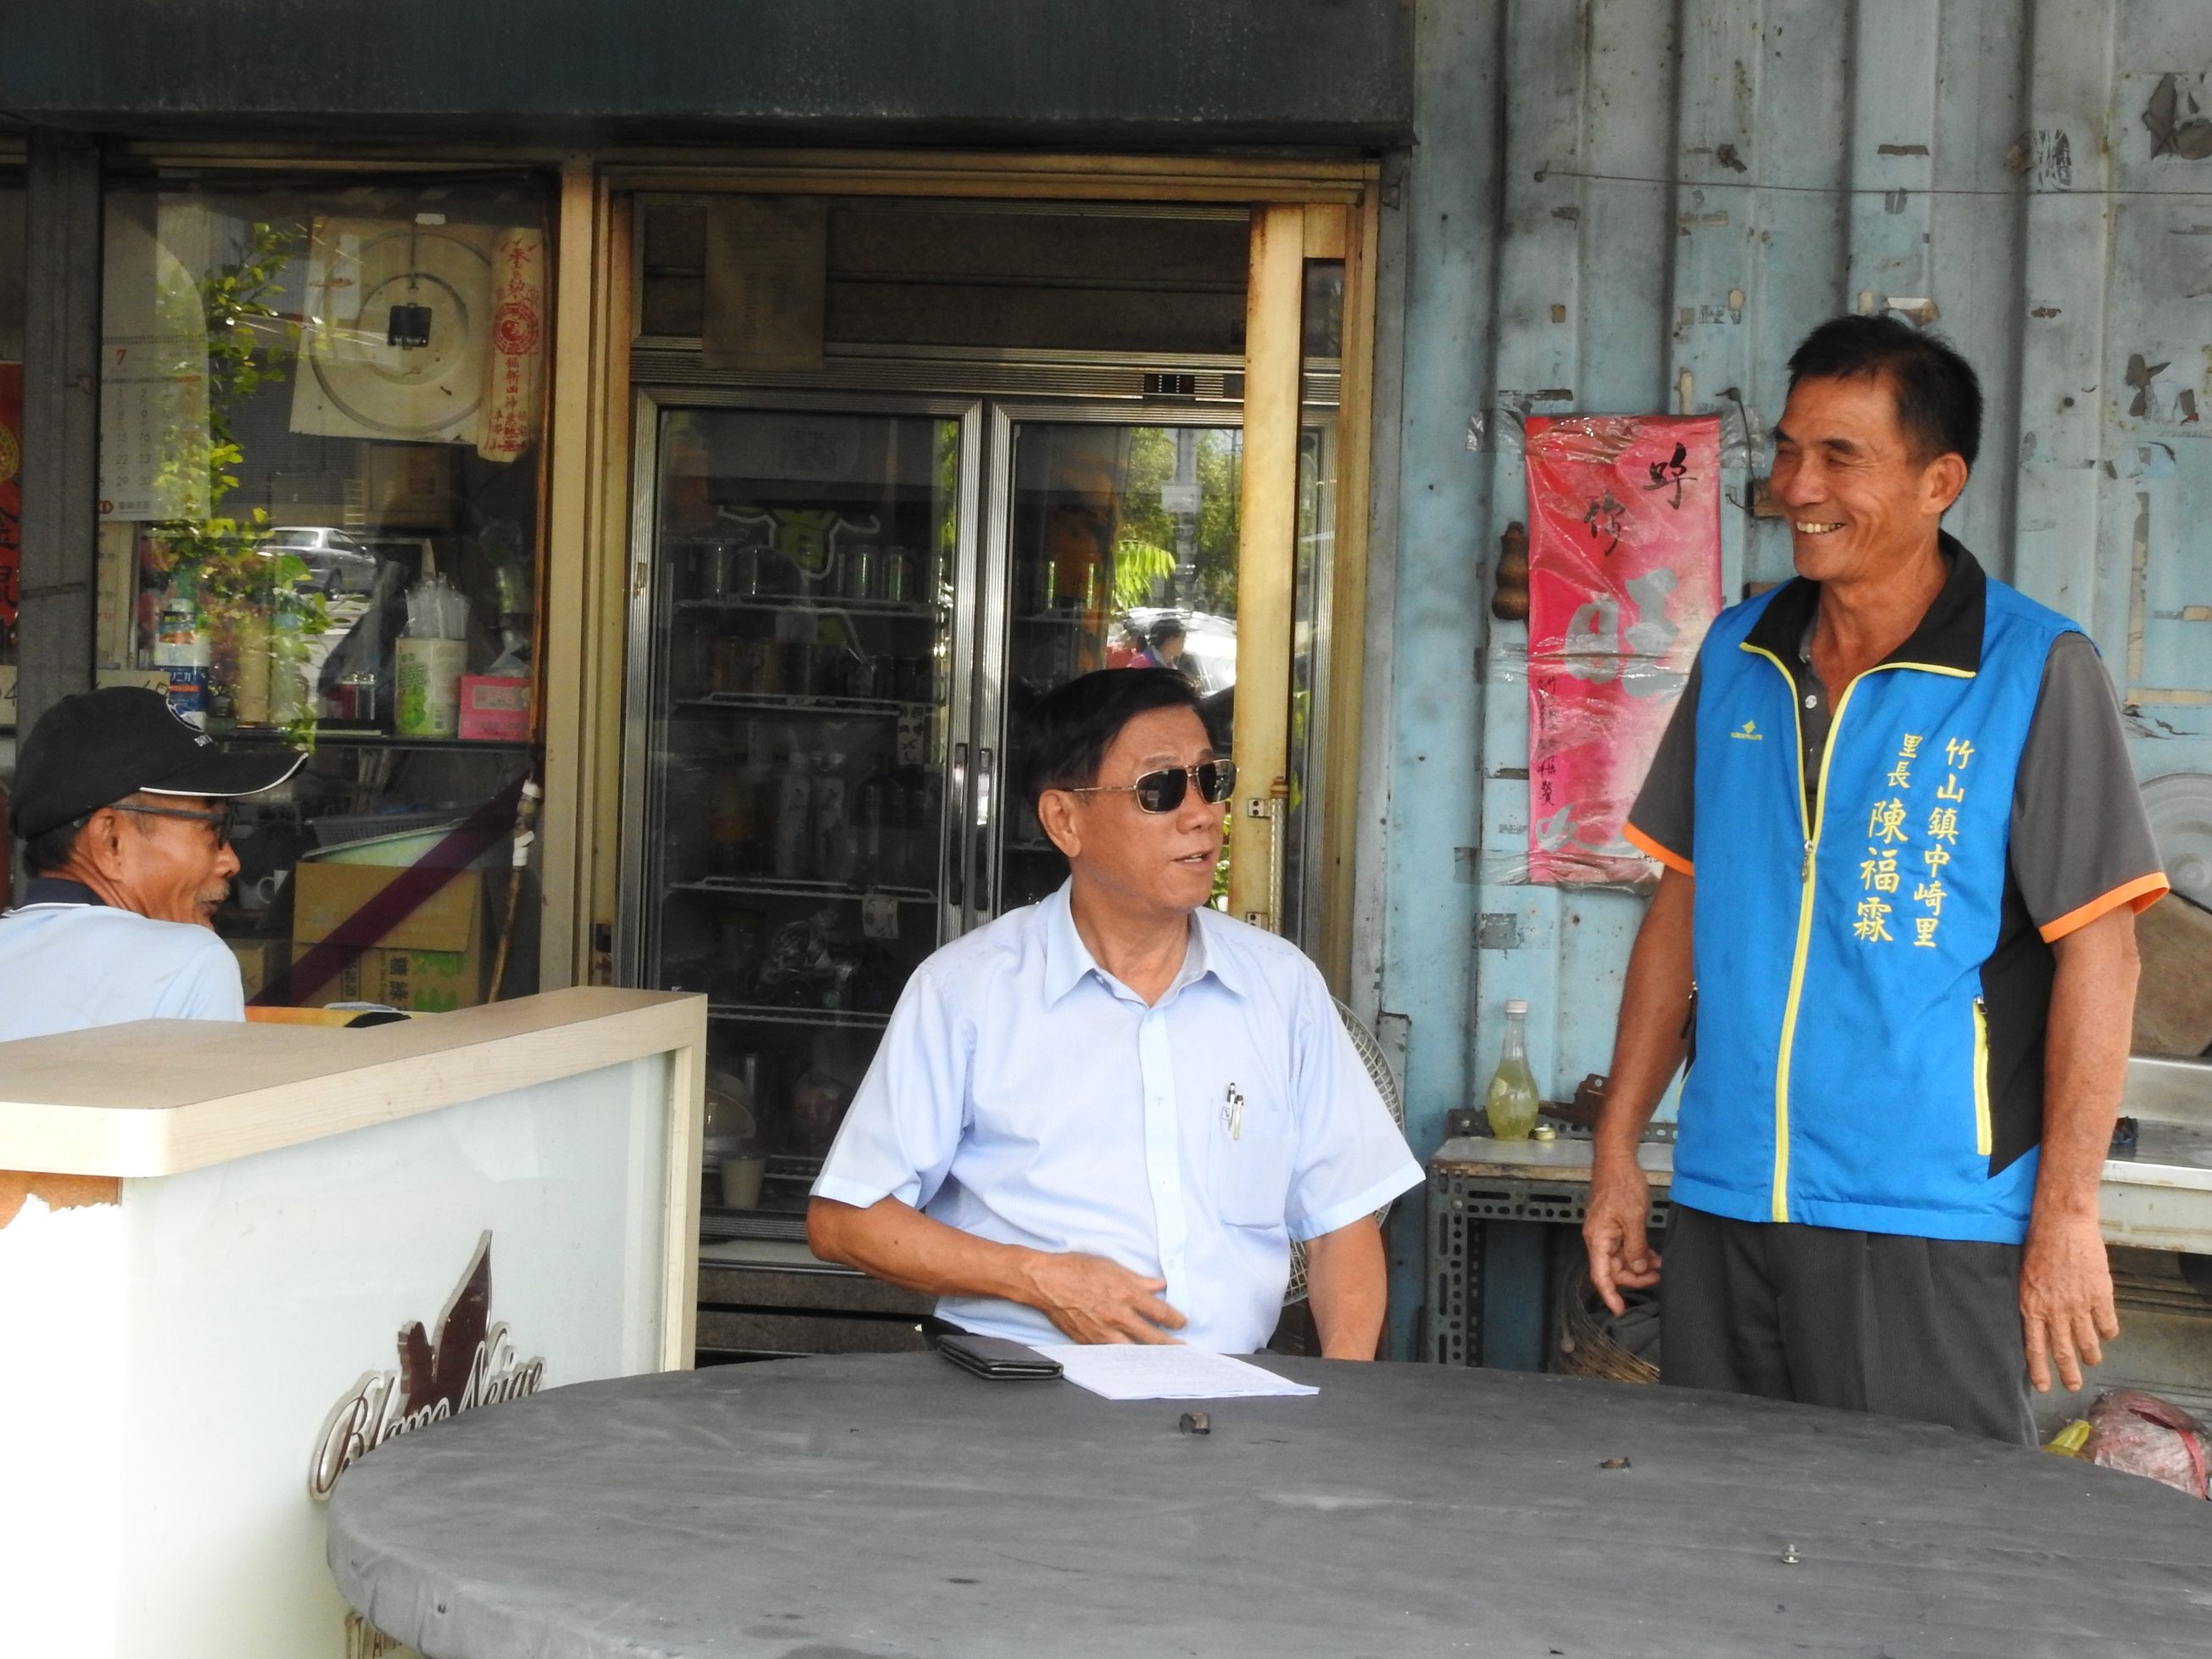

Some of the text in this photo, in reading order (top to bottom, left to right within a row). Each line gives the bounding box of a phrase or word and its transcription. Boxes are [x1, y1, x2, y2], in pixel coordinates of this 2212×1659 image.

[117, 349, 126, 366] 7
[141, 410, 148, 421] 9
[140, 432, 150, 442] 16
[116, 455, 150, 465] 22 23
[116, 476, 128, 487] 29
[1913, 736, 1975, 947] 竹山鎮中崎里
